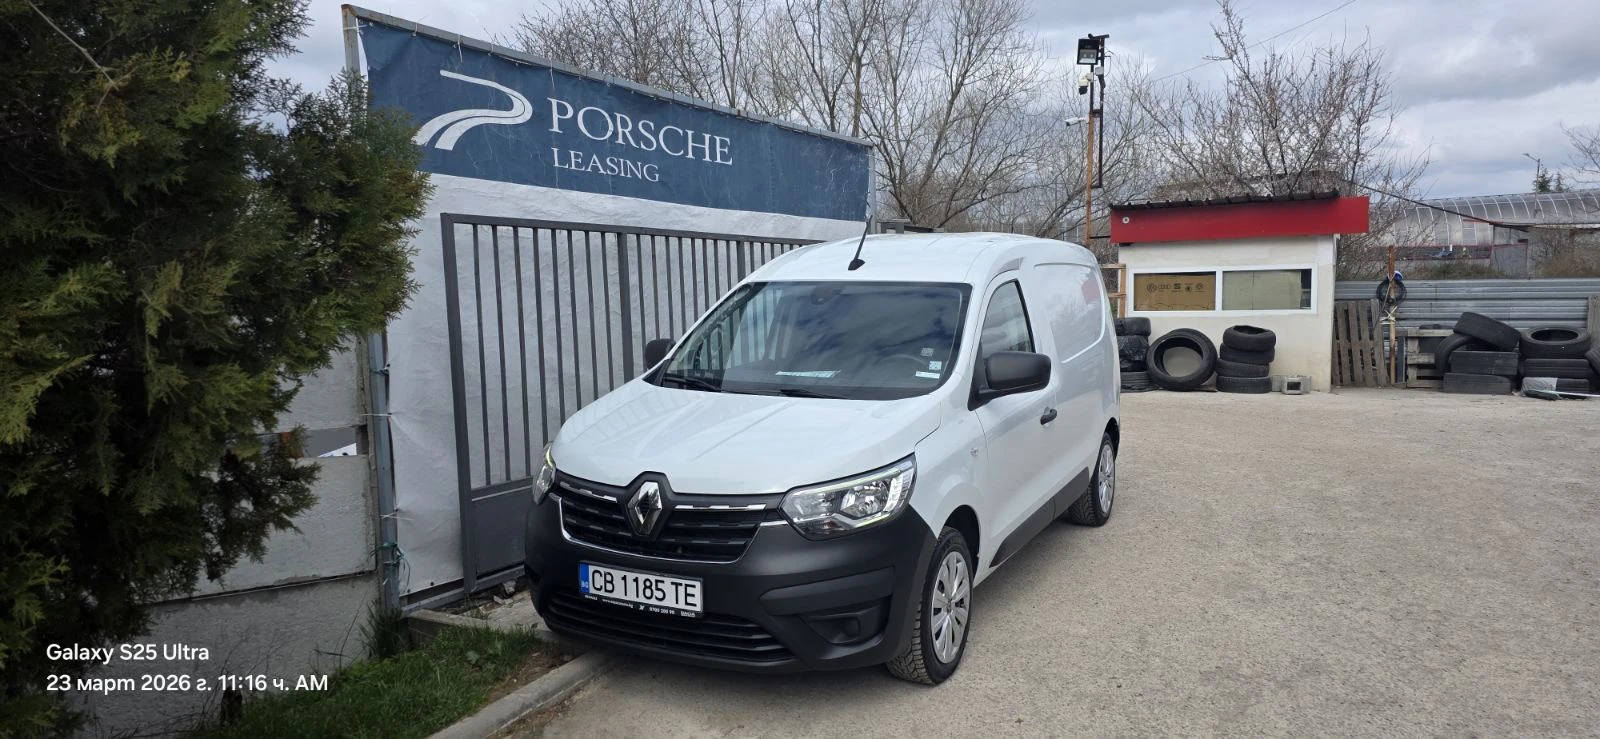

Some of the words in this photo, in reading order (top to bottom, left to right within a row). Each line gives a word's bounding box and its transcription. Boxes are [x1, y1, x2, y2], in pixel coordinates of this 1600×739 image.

[546, 97, 733, 166] PORSCHE
[551, 147, 660, 182] LEASING
[621, 574, 666, 602] 1185
[670, 581, 697, 608] TE
